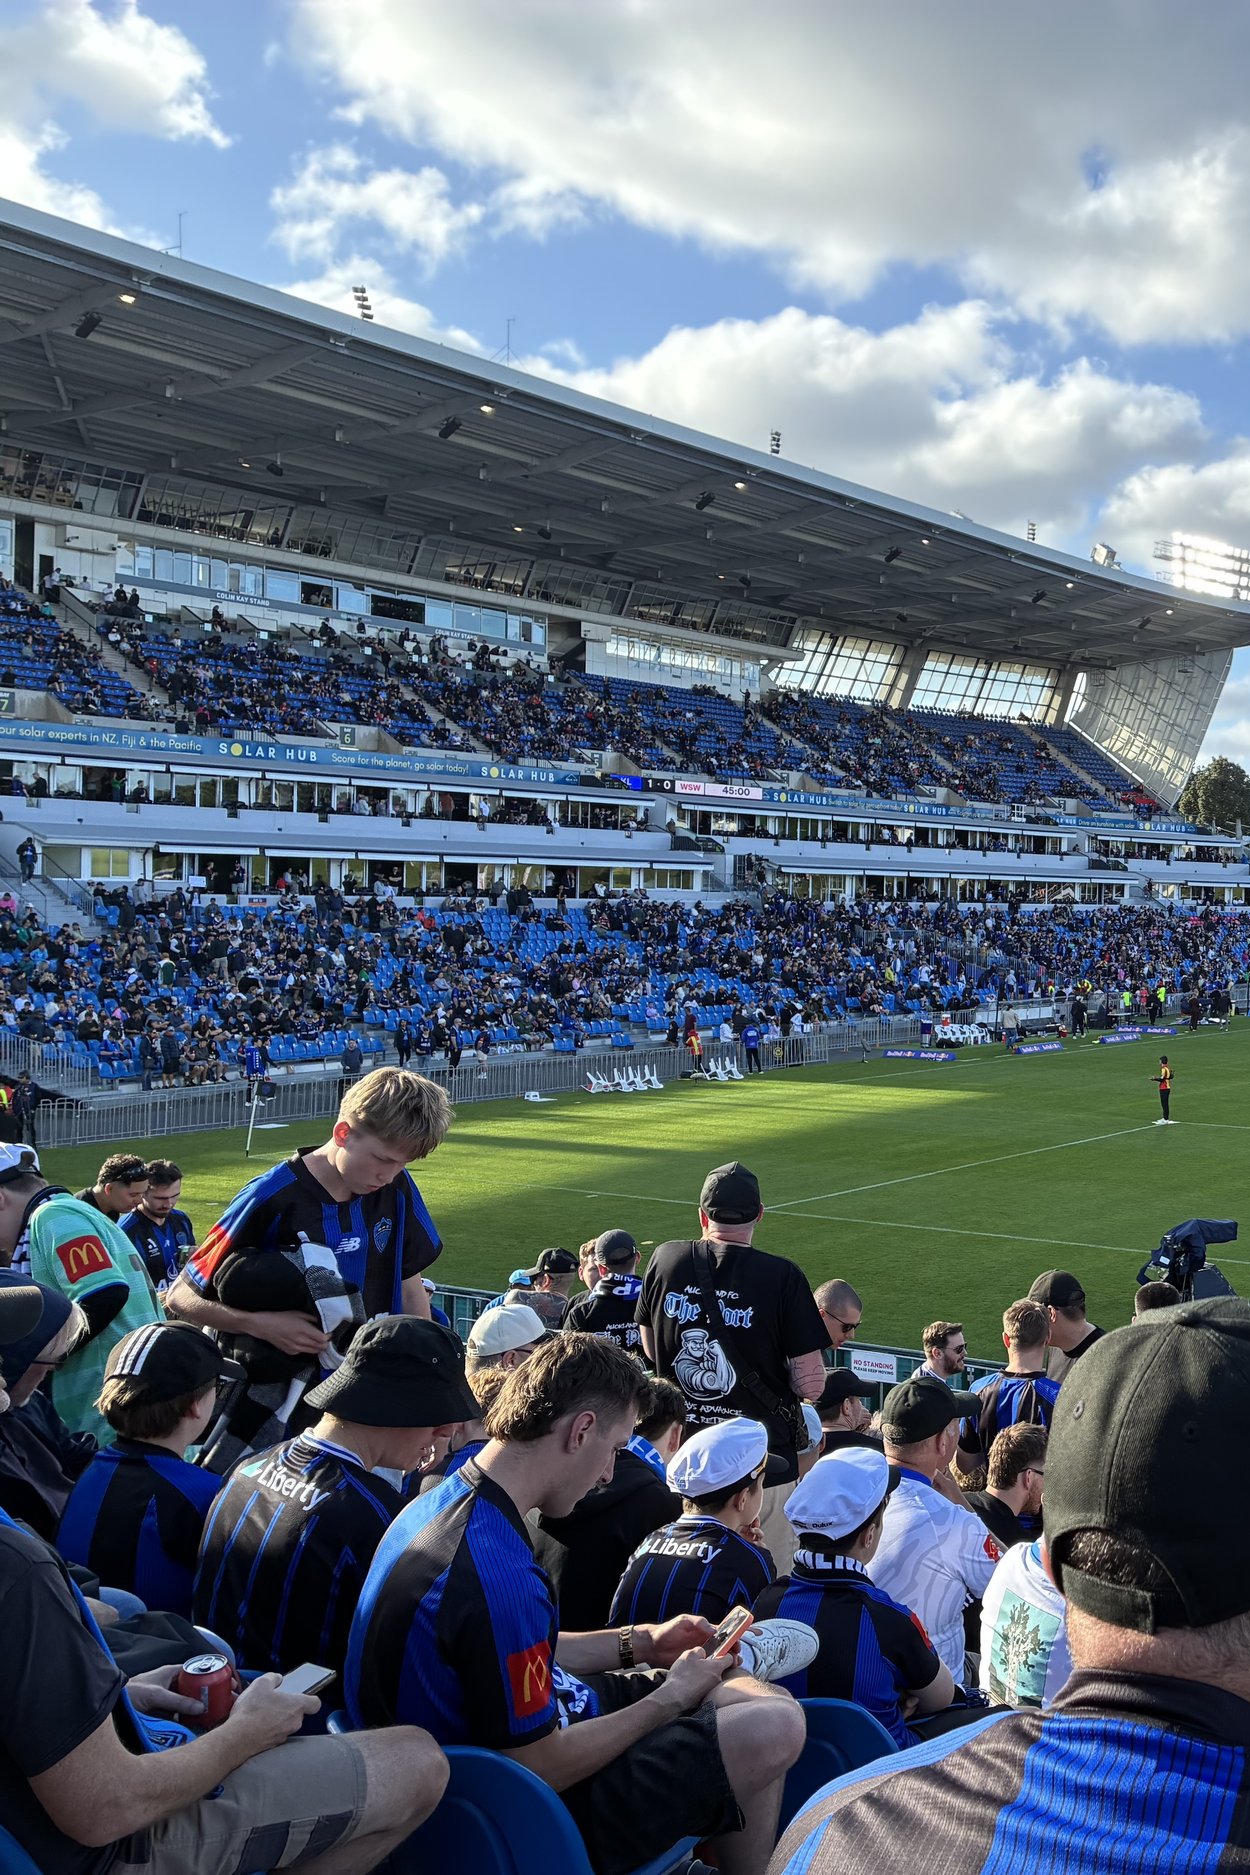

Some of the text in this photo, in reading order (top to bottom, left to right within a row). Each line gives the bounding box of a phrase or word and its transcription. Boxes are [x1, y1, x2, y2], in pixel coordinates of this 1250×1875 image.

[216, 592, 270, 606] COLIN KAY STAND
[19, 726, 45, 738] solar
[48, 731, 87, 743] experts
[90, 732, 99, 743] in
[102, 734, 119, 745] NZ,
[122, 735, 136, 748] Fiji
[139, 737, 147, 746] &
[150, 738, 166, 748] the
[169, 738, 202, 751] Pacific
[344, 733, 351, 744] 6
[218, 743, 317, 762] SOLAR HUB
[331, 754, 356, 764] Score
[358, 755, 369, 765] for
[371, 756, 384, 766] the
[415, 762, 425, 771] go
[426, 760, 444, 771] solar
[446, 763, 469, 775] today!
[481, 767, 524, 780] SOLAR
[531, 770, 555, 782] HUB
[647, 779, 671, 790] 1 0
[680, 783, 701, 792] WSW
[722, 786, 750, 797] 45:00
[773, 792, 827, 805] SOLAR HUB
[903, 804, 929, 814] SOLAR
[932, 807, 947, 815] HUB
[1139, 822, 1167, 831] SOLAR
[727, 1291, 740, 1299] FC
[663, 1291, 702, 1325] The
[605, 1322, 639, 1331] AUCKLAND
[863, 1360, 894, 1370] STANDING
[257, 1461, 331, 1511] Liberty
[811, 1521, 833, 1529] Dulux
[648, 1538, 722, 1564] Liberty
